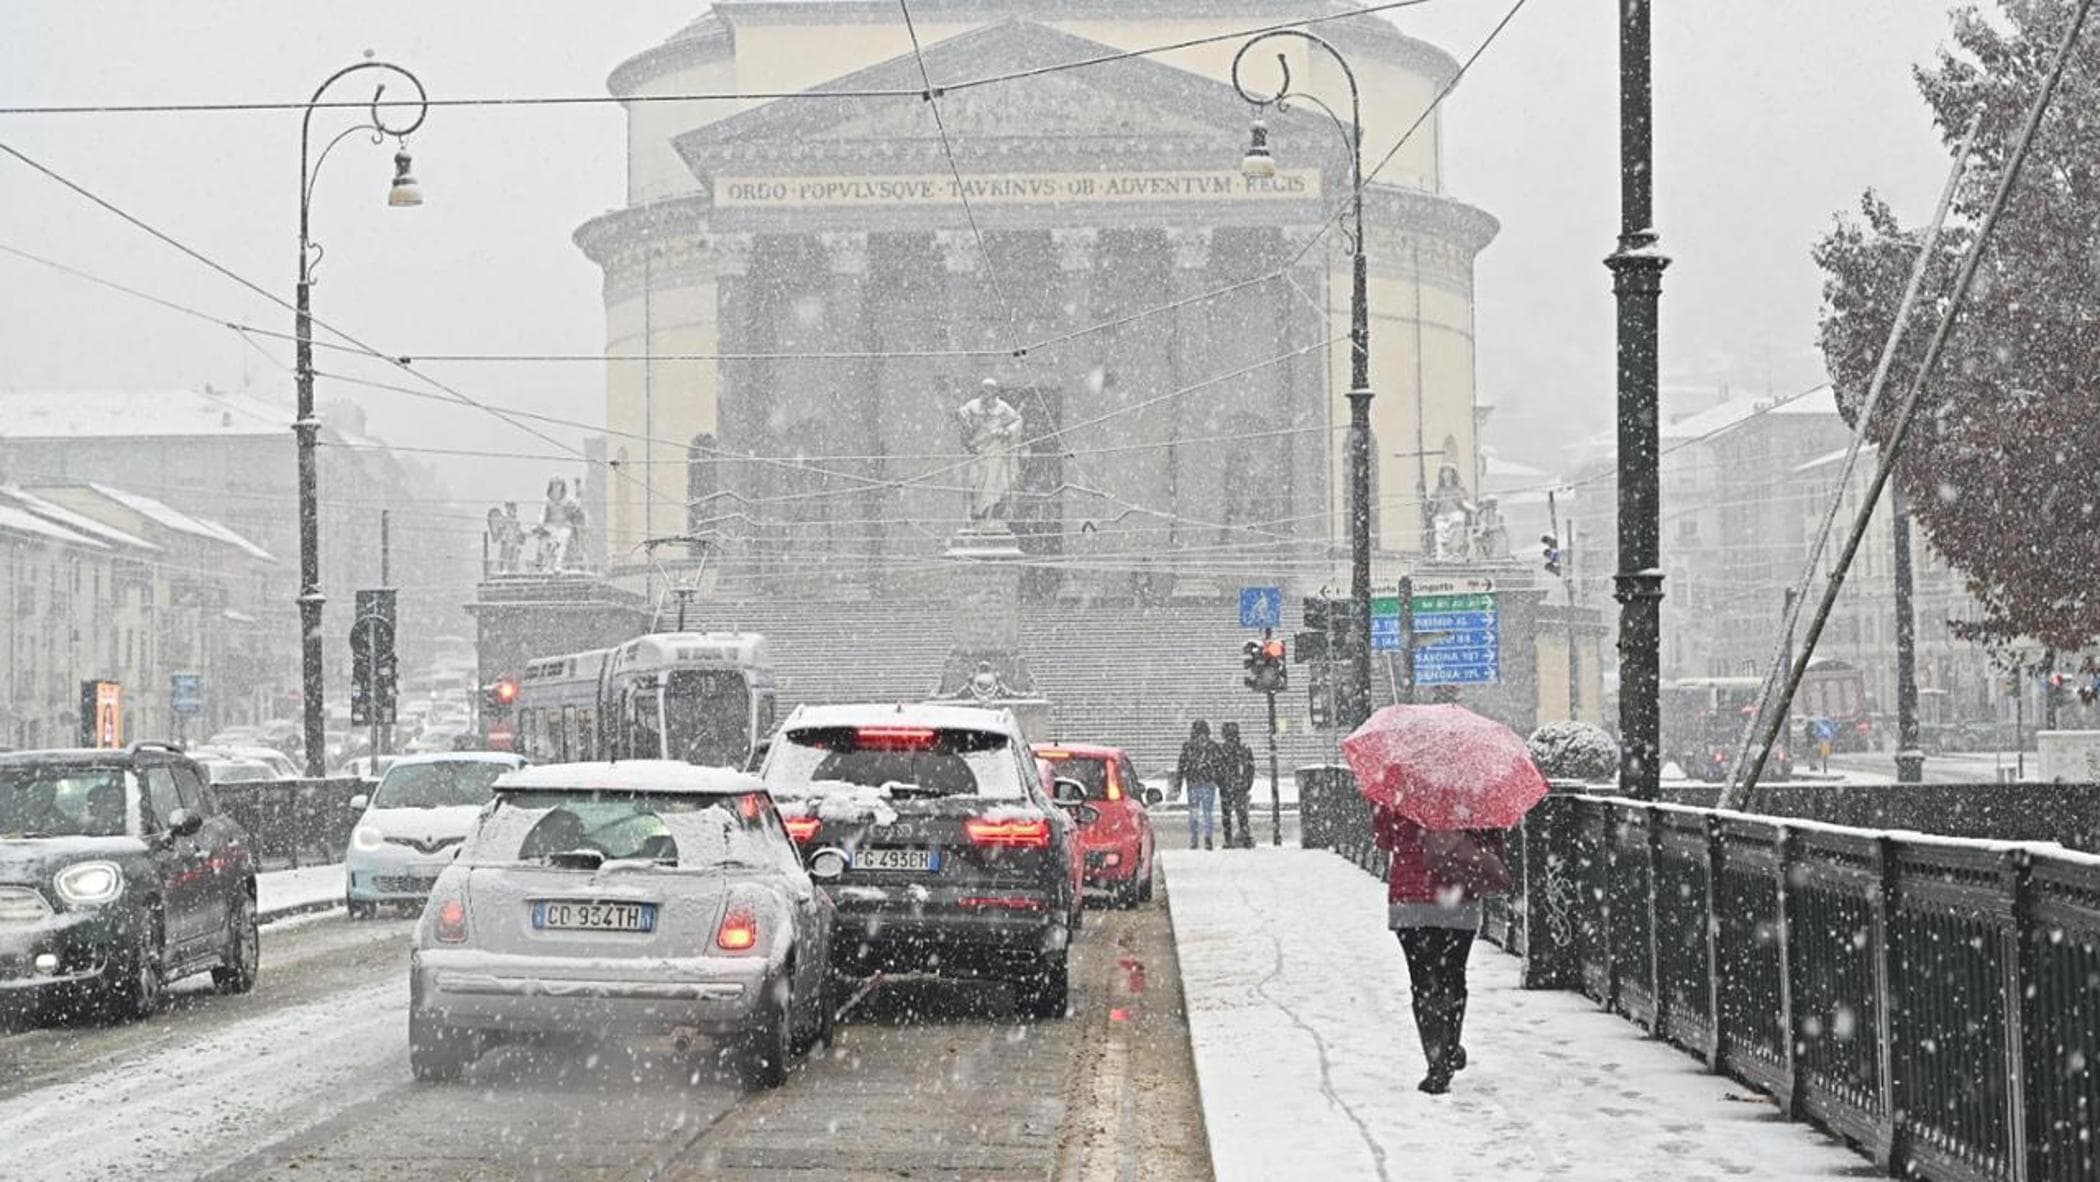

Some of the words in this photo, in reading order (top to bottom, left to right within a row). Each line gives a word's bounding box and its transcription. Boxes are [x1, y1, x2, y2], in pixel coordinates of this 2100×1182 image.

[728, 183, 787, 200] ORDO
[800, 181, 935, 199] POPVLVSQVE
[950, 179, 1055, 198] TAVRINVS
[1067, 178, 1095, 195] OB
[1106, 176, 1232, 195] ADVENTVM
[1245, 174, 1306, 193] REGIS
[1413, 582, 1454, 593] Lingotto
[548, 905, 571, 925] CD
[578, 906, 639, 928] 934TH
